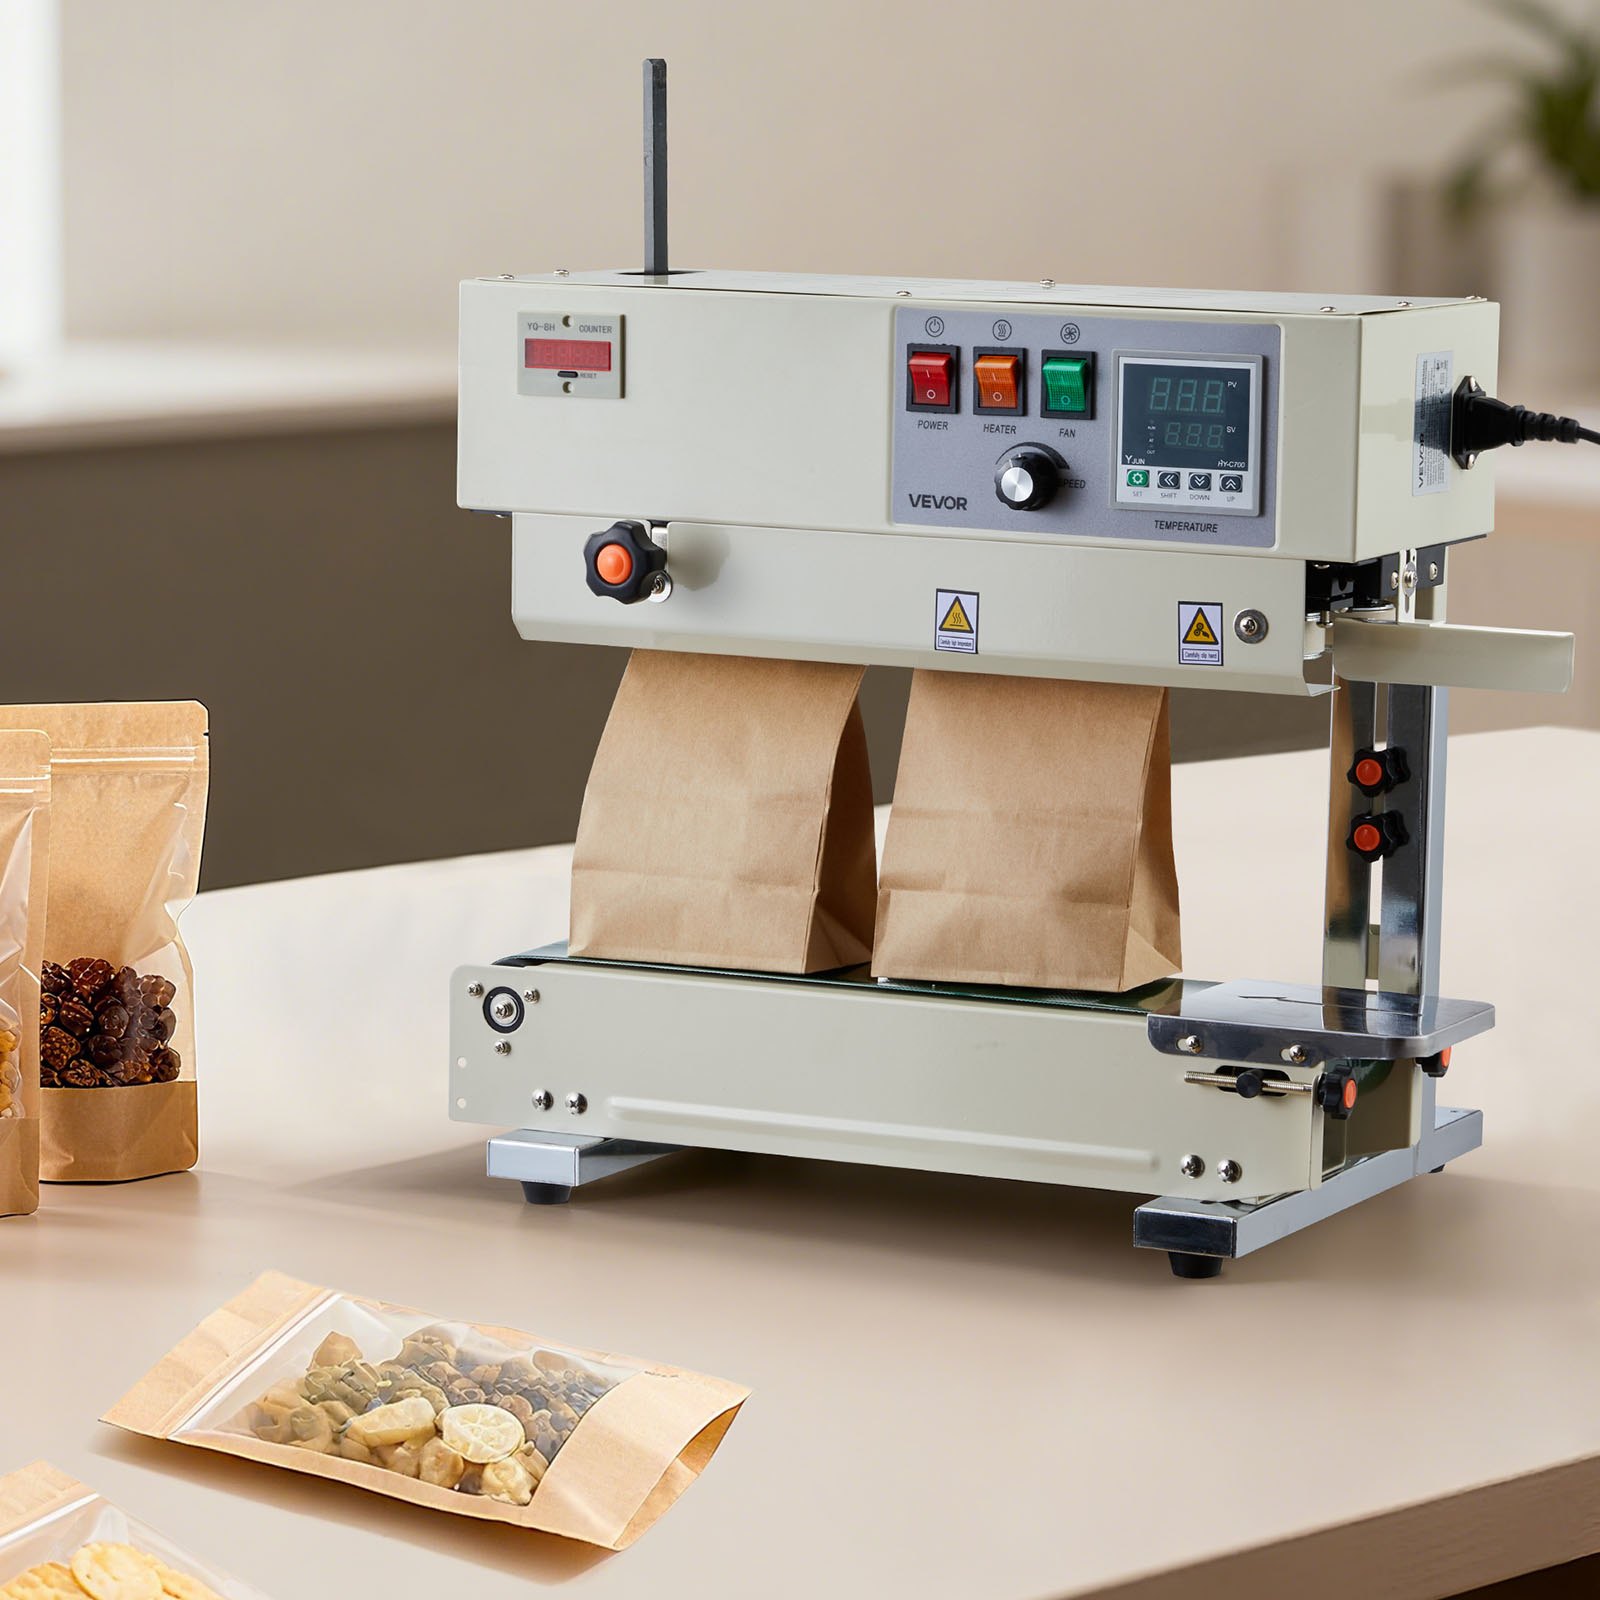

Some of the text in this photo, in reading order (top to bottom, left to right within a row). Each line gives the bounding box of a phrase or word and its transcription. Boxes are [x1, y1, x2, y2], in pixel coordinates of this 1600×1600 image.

[579, 324, 612, 334] COUNTER
[917, 420, 949, 430] POWER
[983, 424, 1017, 434] HEATER
[1226, 425, 1236, 433] SV
[1059, 428, 1076, 438] FAN
[1063, 479, 1086, 489] PEED
[909, 493, 968, 511] VEVOR
[1154, 520, 1219, 533] TEMPERATURE
